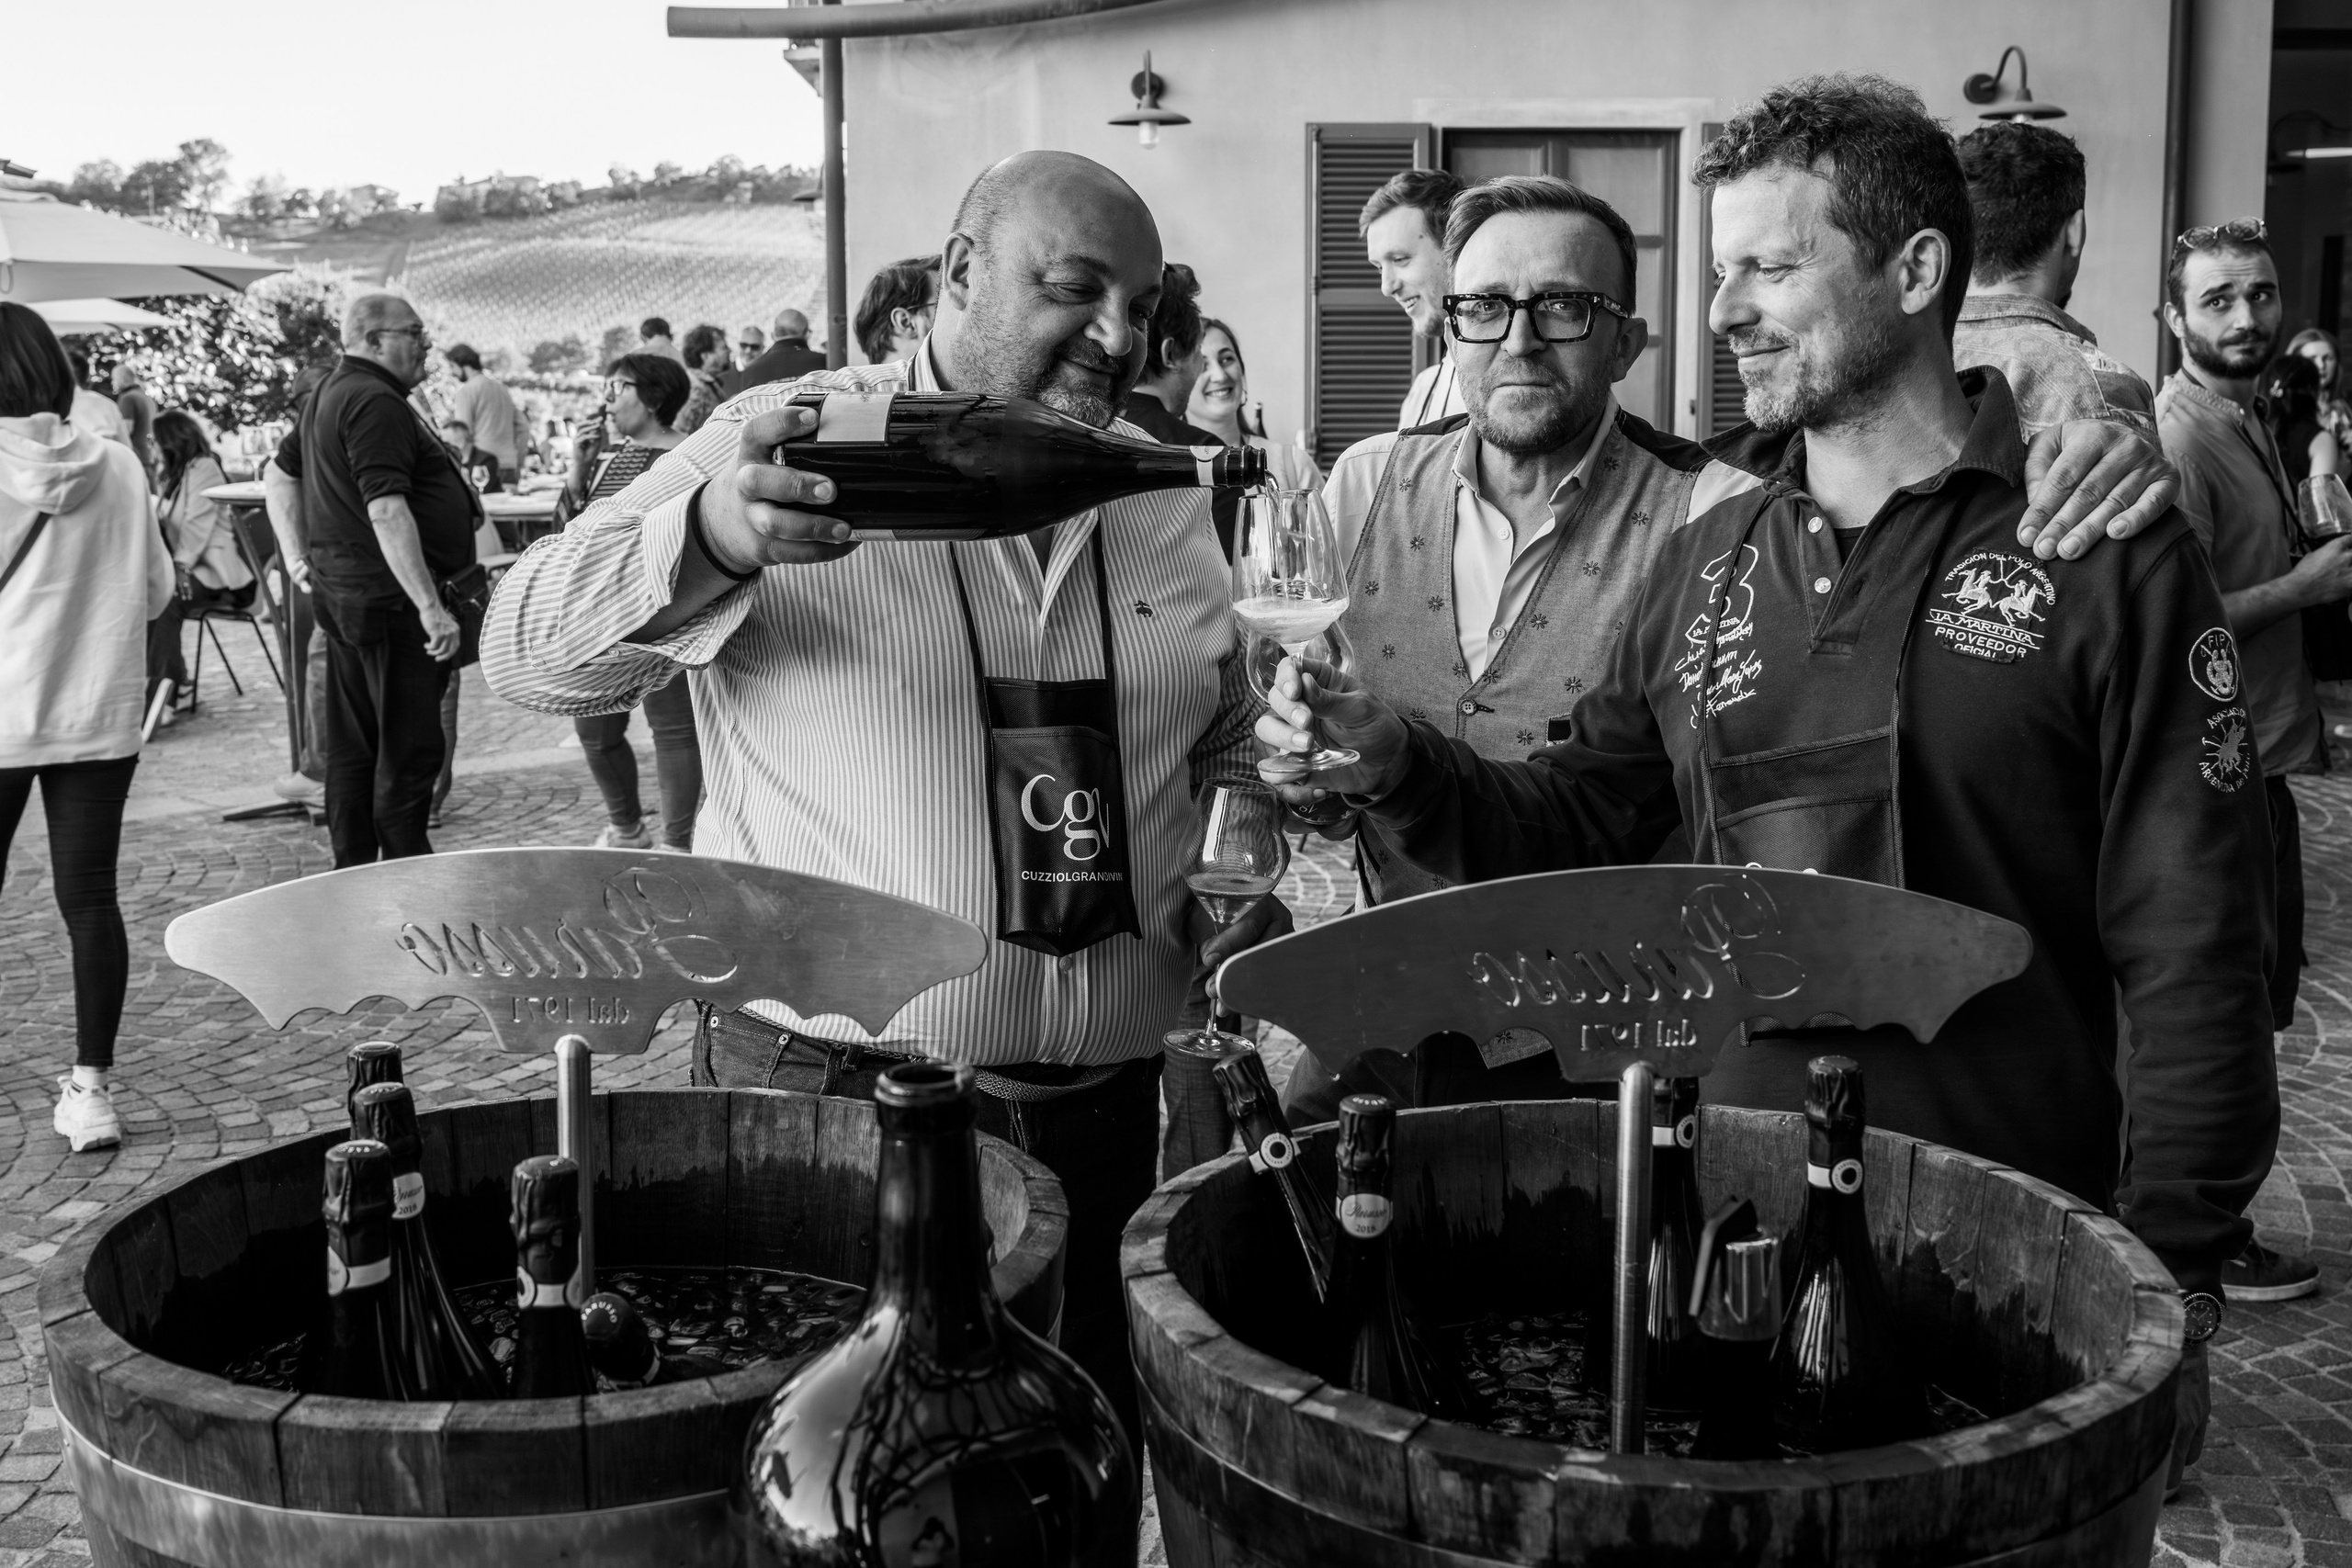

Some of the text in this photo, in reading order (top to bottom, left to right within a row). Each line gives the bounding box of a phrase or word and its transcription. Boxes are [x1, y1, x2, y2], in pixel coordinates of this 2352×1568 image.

[1935, 626, 2027, 658] PROVEEDOR
[1955, 617, 2036, 646] MARTINA
[2208, 634, 2226, 648] FIP
